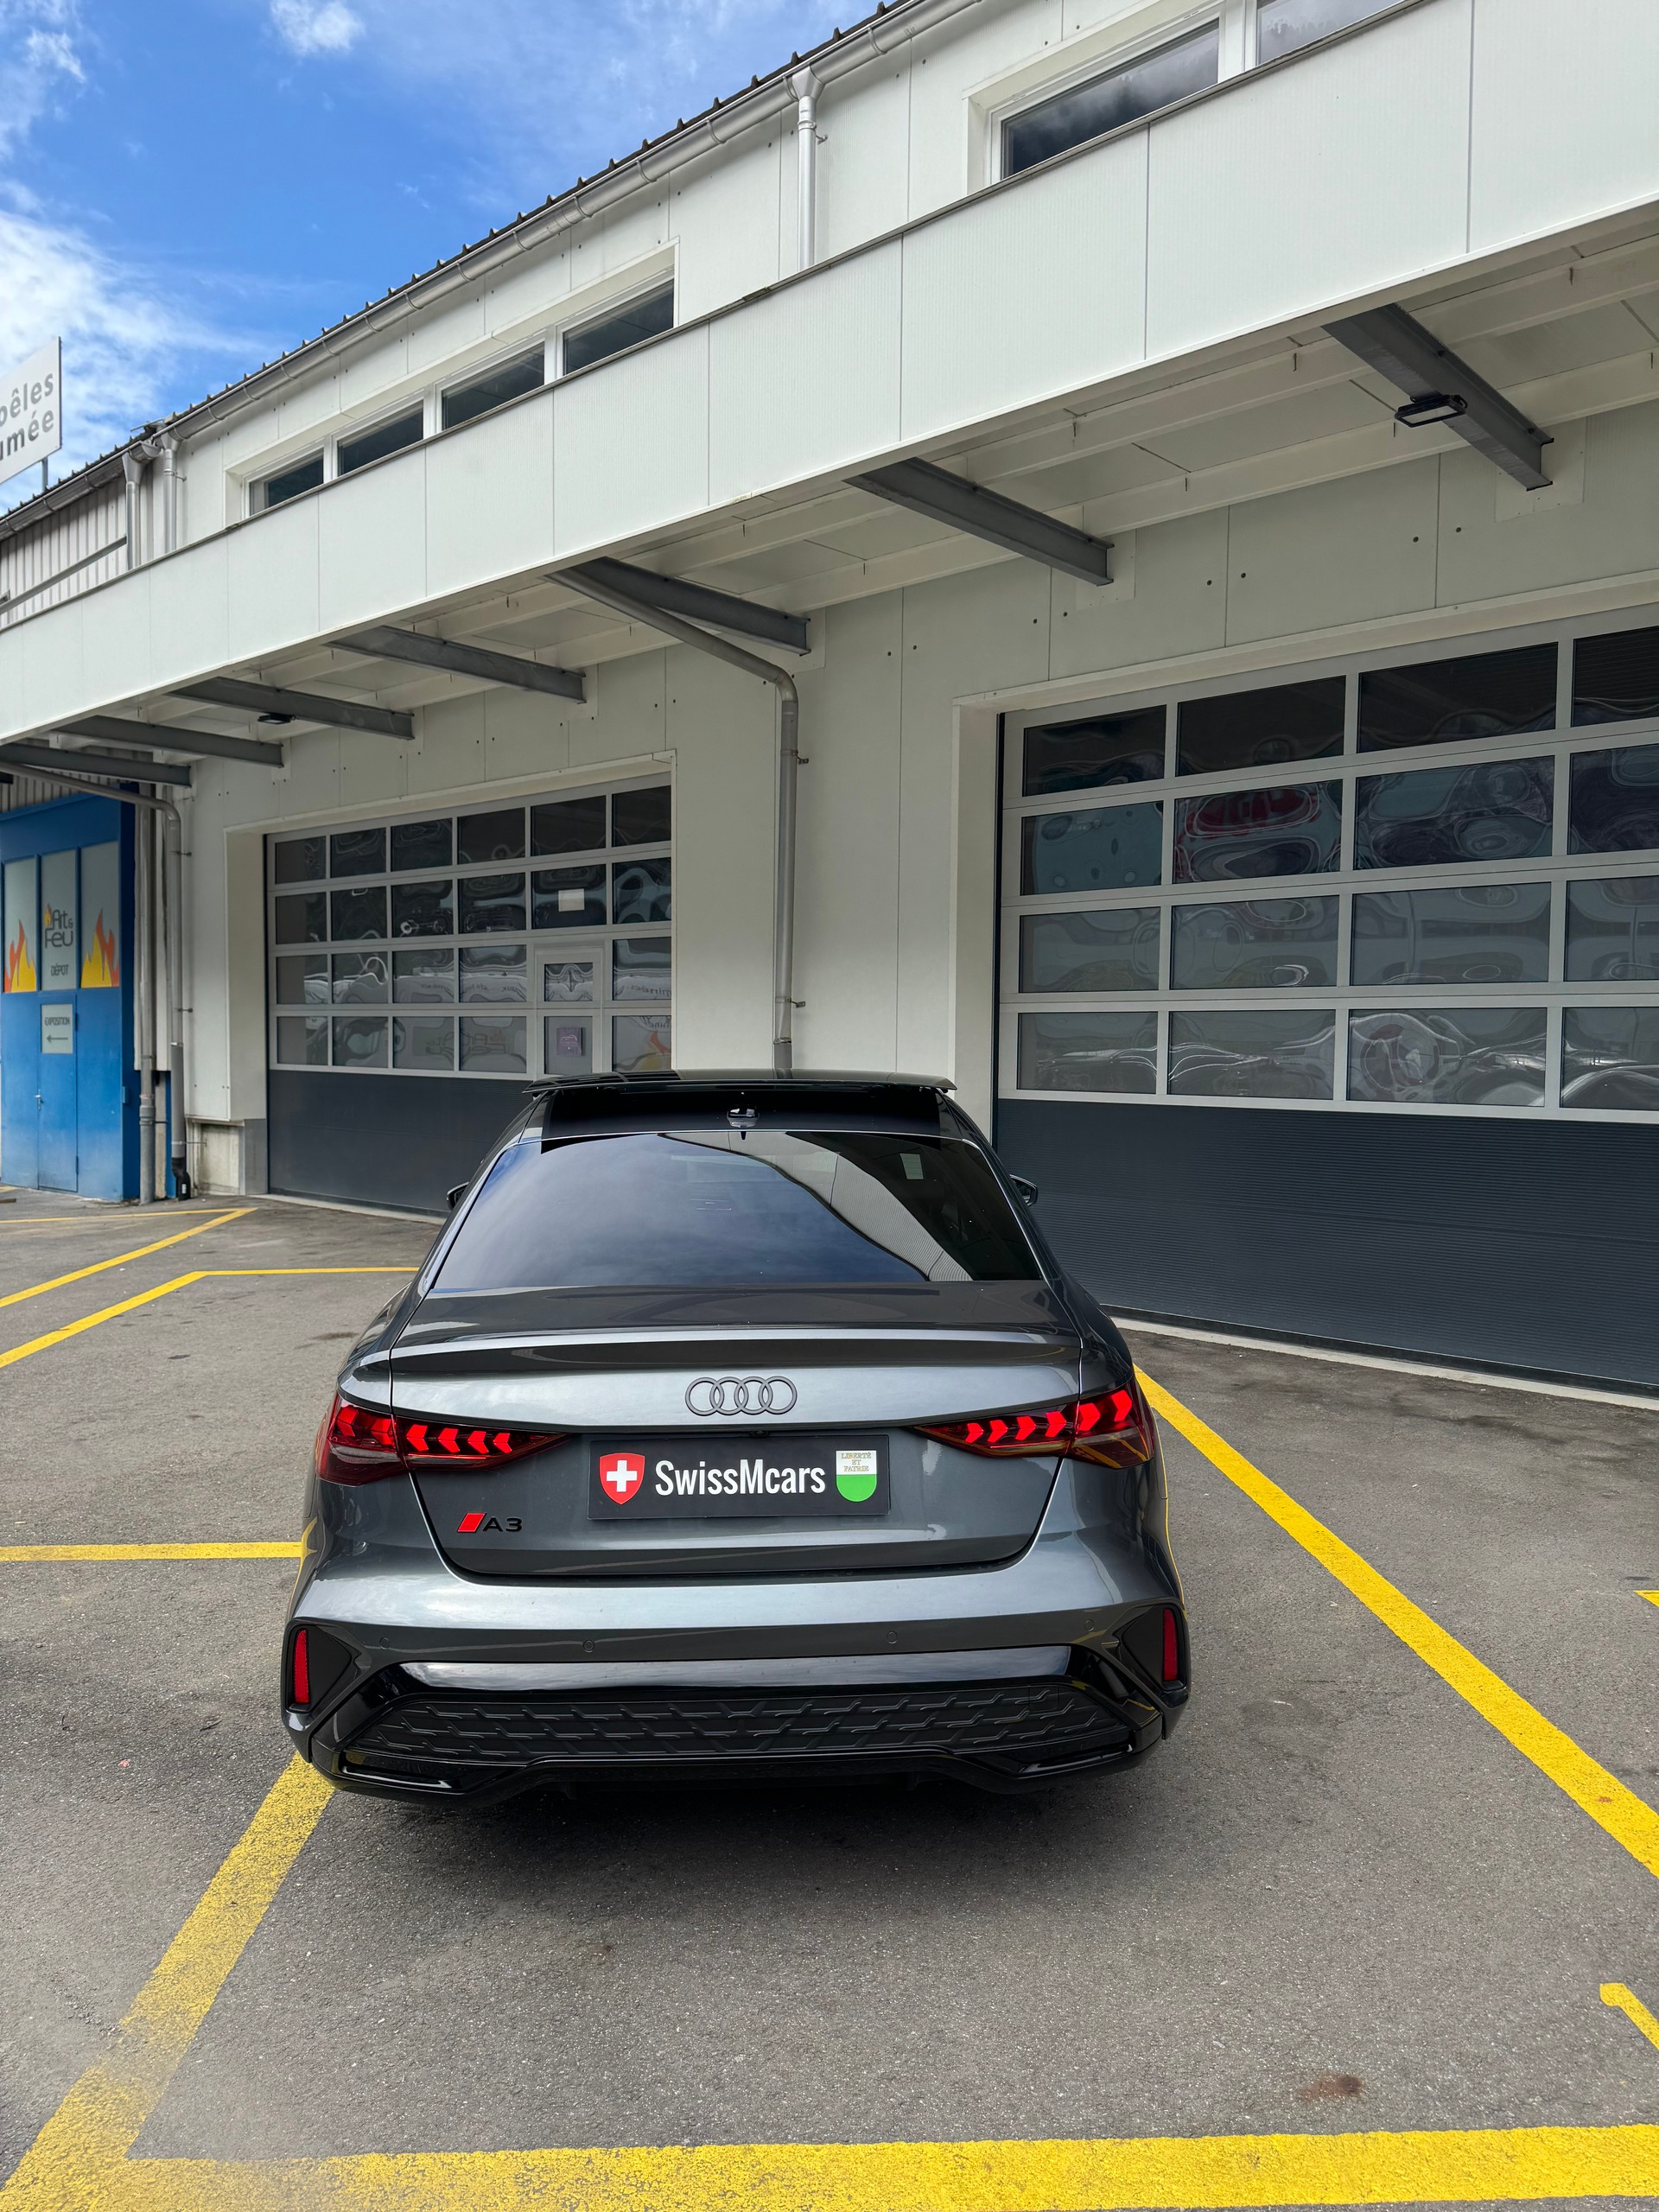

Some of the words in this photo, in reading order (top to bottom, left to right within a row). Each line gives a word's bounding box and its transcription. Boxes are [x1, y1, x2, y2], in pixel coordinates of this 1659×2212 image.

[0, 410, 54, 452] mée
[52, 909, 68, 930] Art
[50, 963, 69, 976] DÉPOT
[44, 1016, 71, 1027] EXPOSITION
[655, 1459, 827, 1497] SwissMcars
[482, 1516, 523, 1533] A3
